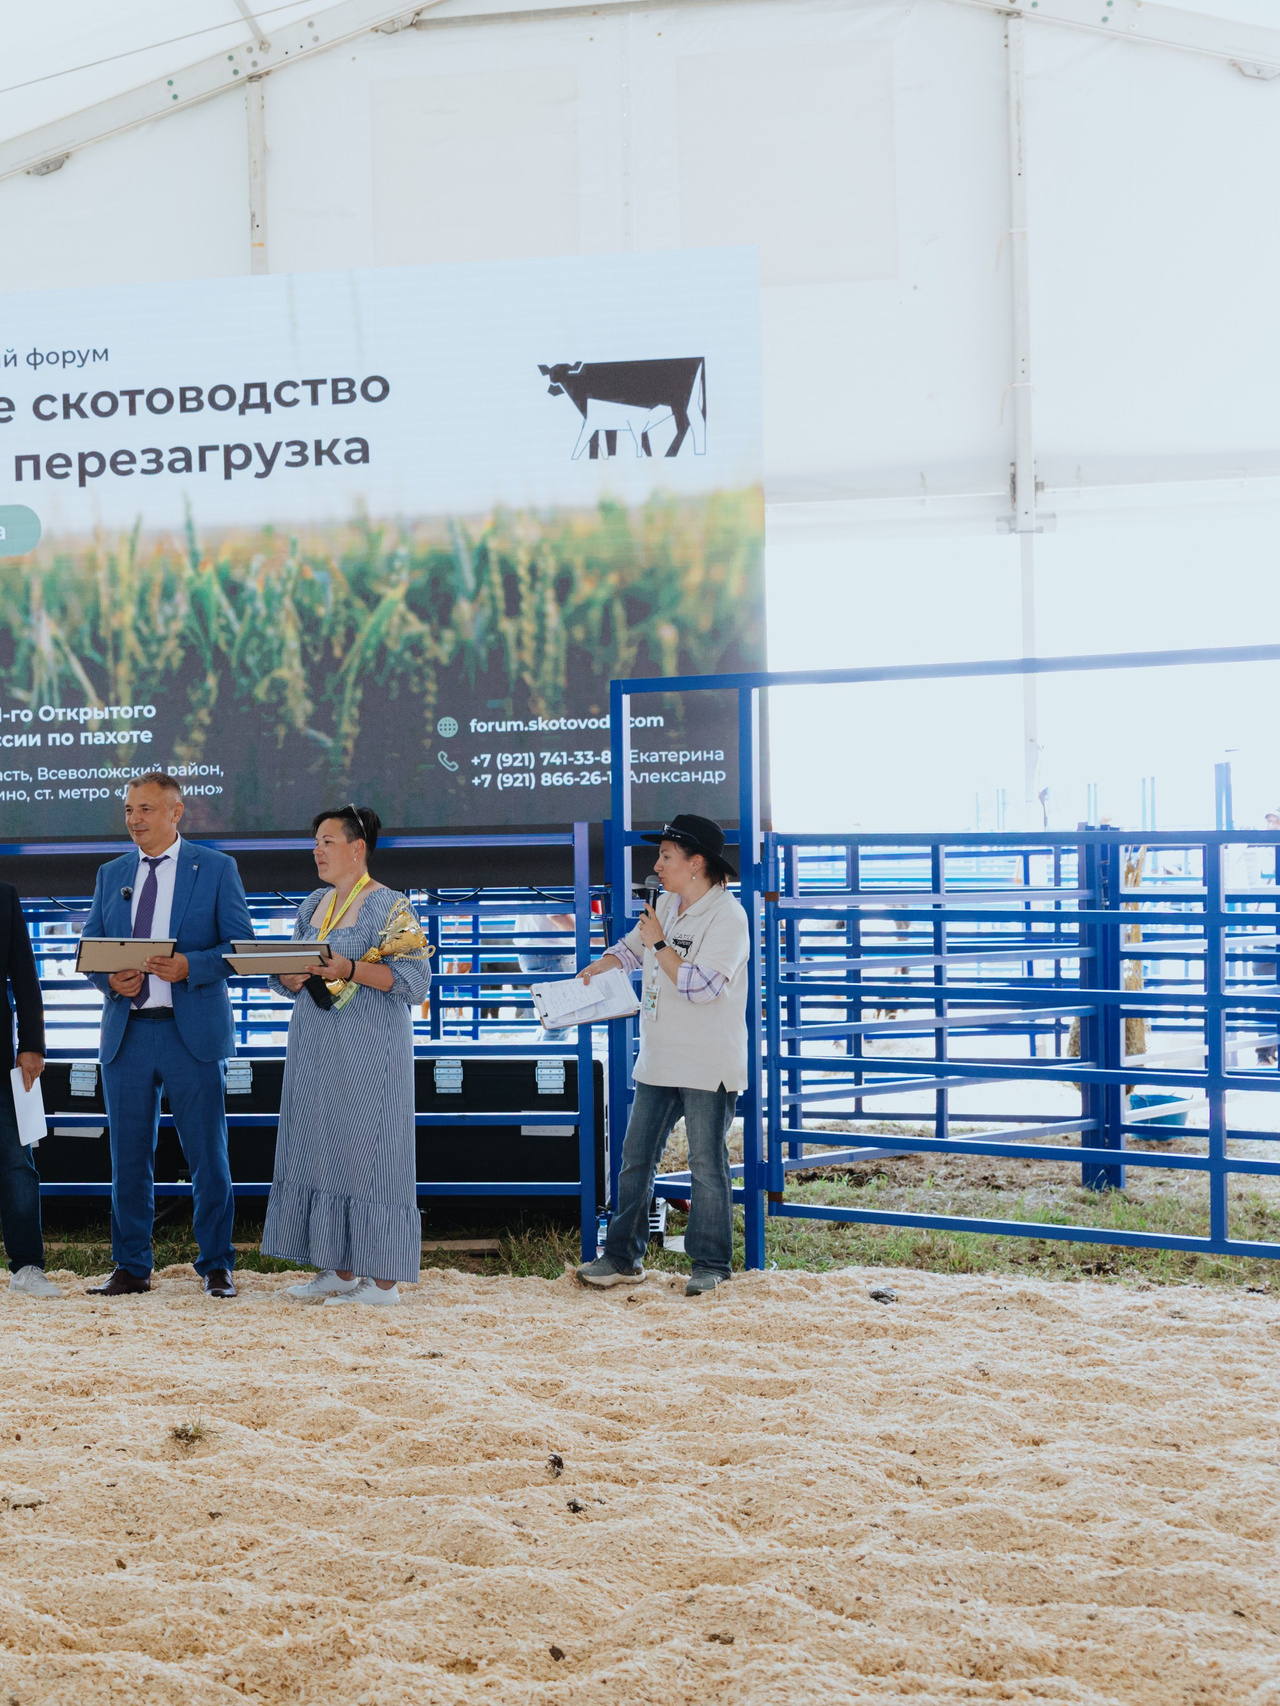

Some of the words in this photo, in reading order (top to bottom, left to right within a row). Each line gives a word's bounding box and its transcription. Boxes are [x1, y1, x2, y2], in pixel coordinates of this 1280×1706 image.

[25, 345, 110, 372] форум
[31, 374, 391, 421] скотоводство
[14, 436, 371, 488] перезагрузка
[38, 704, 157, 724] Открытого
[47, 733, 74, 746] по
[80, 730, 153, 745] пахоте
[471, 754, 492, 768] +7
[496, 752, 536, 770] (921)
[539, 750, 621, 766] 741-33-8
[629, 749, 725, 765] Екатерина
[167, 762, 225, 779] район,
[471, 774, 492, 788] +7
[496, 772, 536, 791] (921)
[629, 770, 726, 785] Александр
[34, 789, 54, 800] ст.
[58, 787, 110, 802] метро
